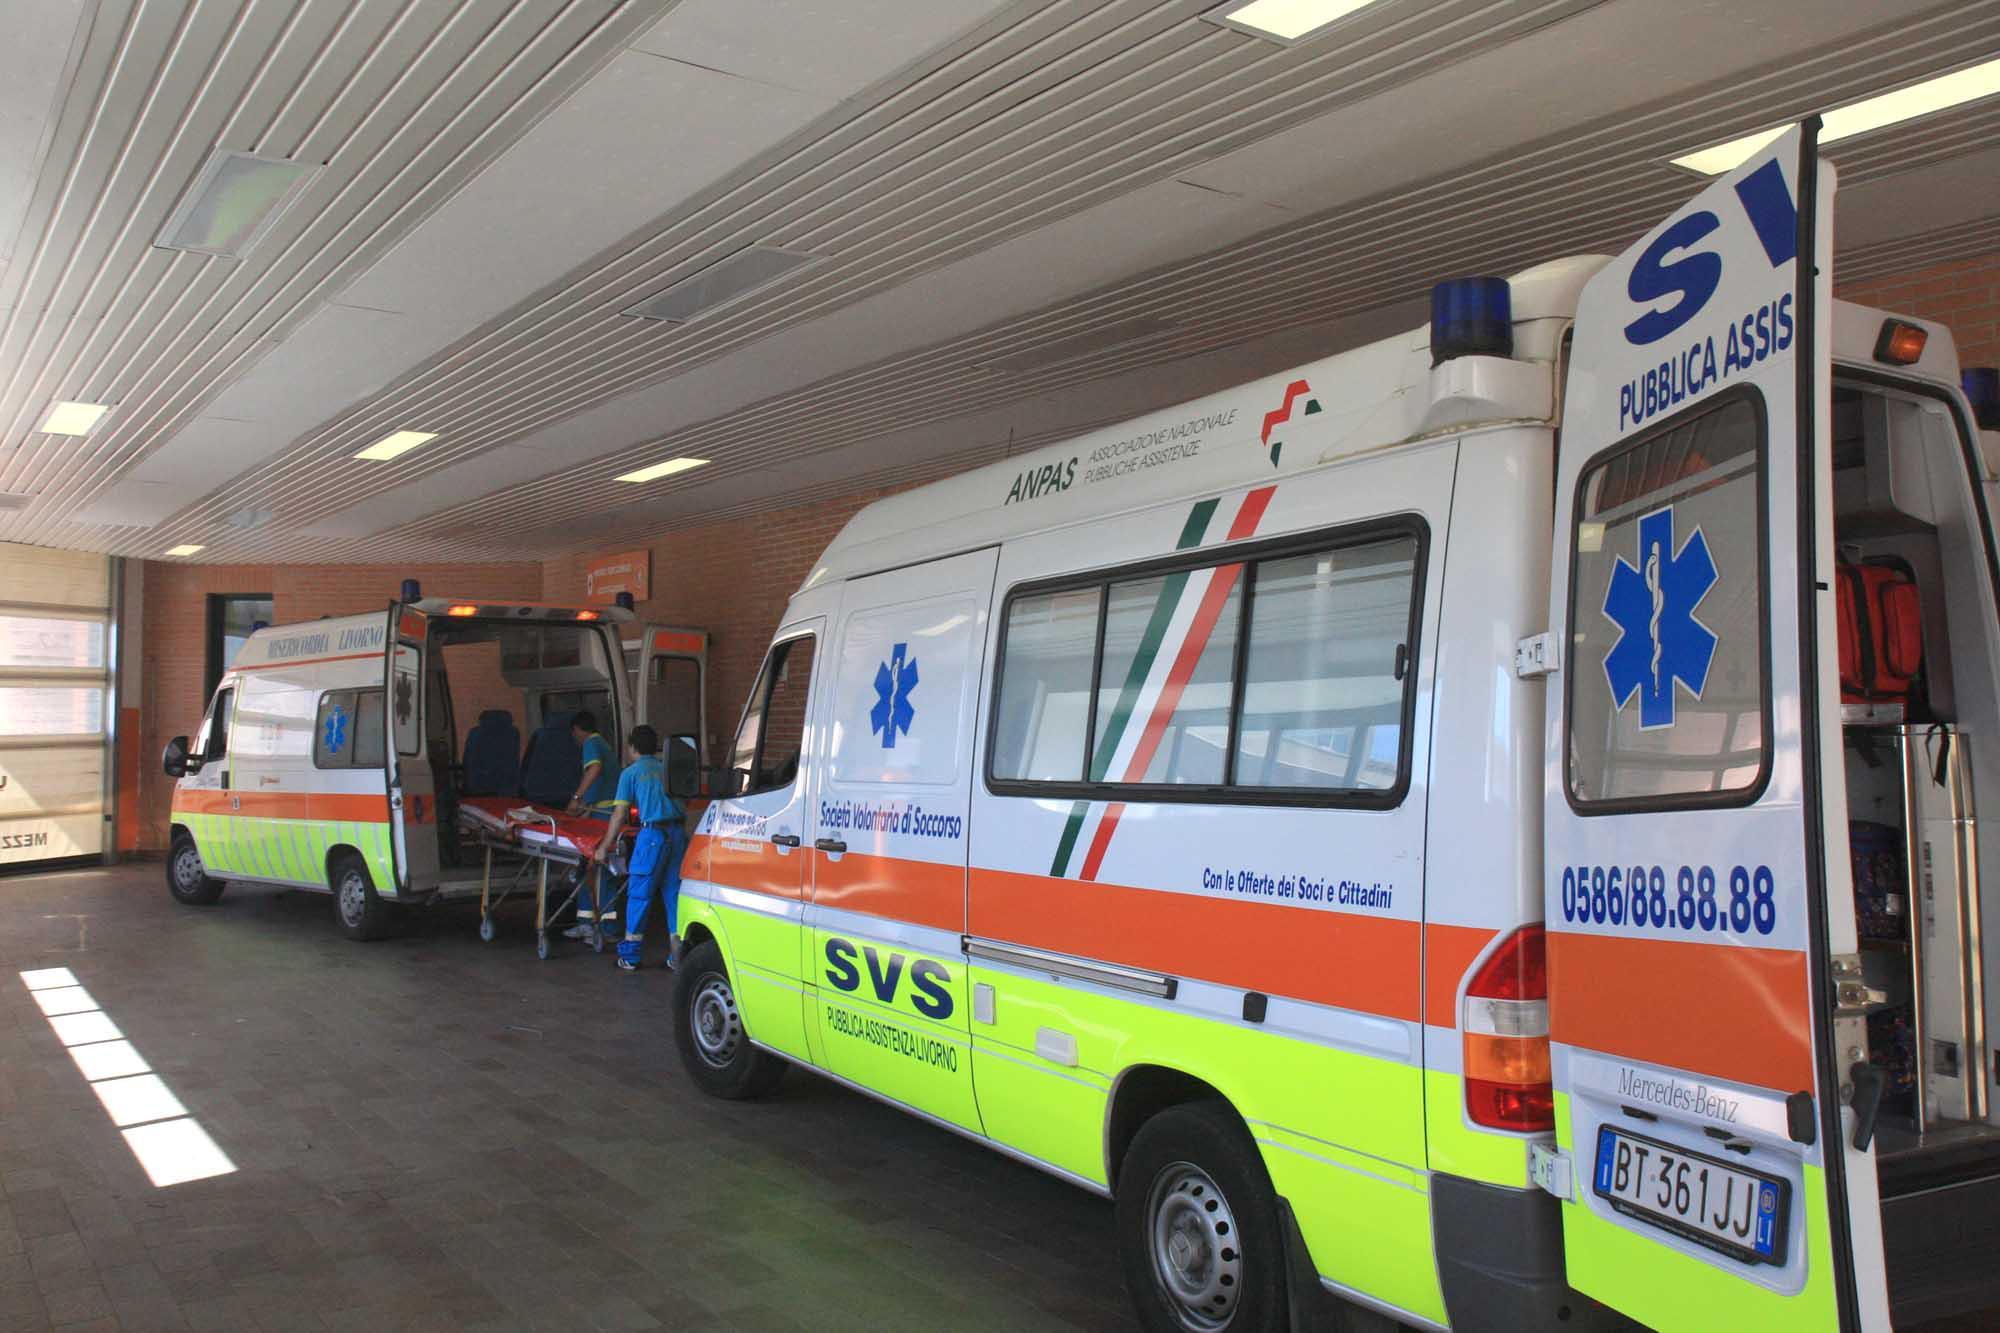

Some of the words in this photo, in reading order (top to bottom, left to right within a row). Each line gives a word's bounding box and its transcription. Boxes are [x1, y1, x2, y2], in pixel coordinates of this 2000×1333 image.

[1620, 335, 1717, 432] PUBBLICA
[1723, 293, 1793, 378] ASSIS
[1084, 457, 1138, 484] PUBBLICHE
[1137, 440, 1202, 471] ASSISTENZE
[1088, 430, 1168, 463] ASSOCIAZIONE
[1168, 408, 1239, 440] NAZIONALE
[1004, 456, 1078, 506] ANPAS
[338, 624, 383, 650] LIVORNO
[820, 800, 850, 829] Società
[852, 804, 899, 835] Volontaria
[901, 806, 912, 835] di
[913, 807, 961, 839] Soccorso
[1202, 867, 1222, 890] Con
[1225, 869, 1235, 892] le
[1237, 870, 1275, 896] Offerte
[1277, 875, 1295, 898] dei
[1298, 876, 1324, 901] Soci
[1326, 884, 1334, 903] e
[1338, 881, 1393, 909] Cittadini
[1562, 865, 1776, 935] 0586/88.88.88
[825, 937, 954, 1020] SVS
[827, 1006, 865, 1038] PUBBLICA
[865, 1020, 917, 1059] ASSISTENZA
[917, 1037, 957, 1073] LIVORNO
[1617, 1067, 1739, 1124] Mercedes-Benz
